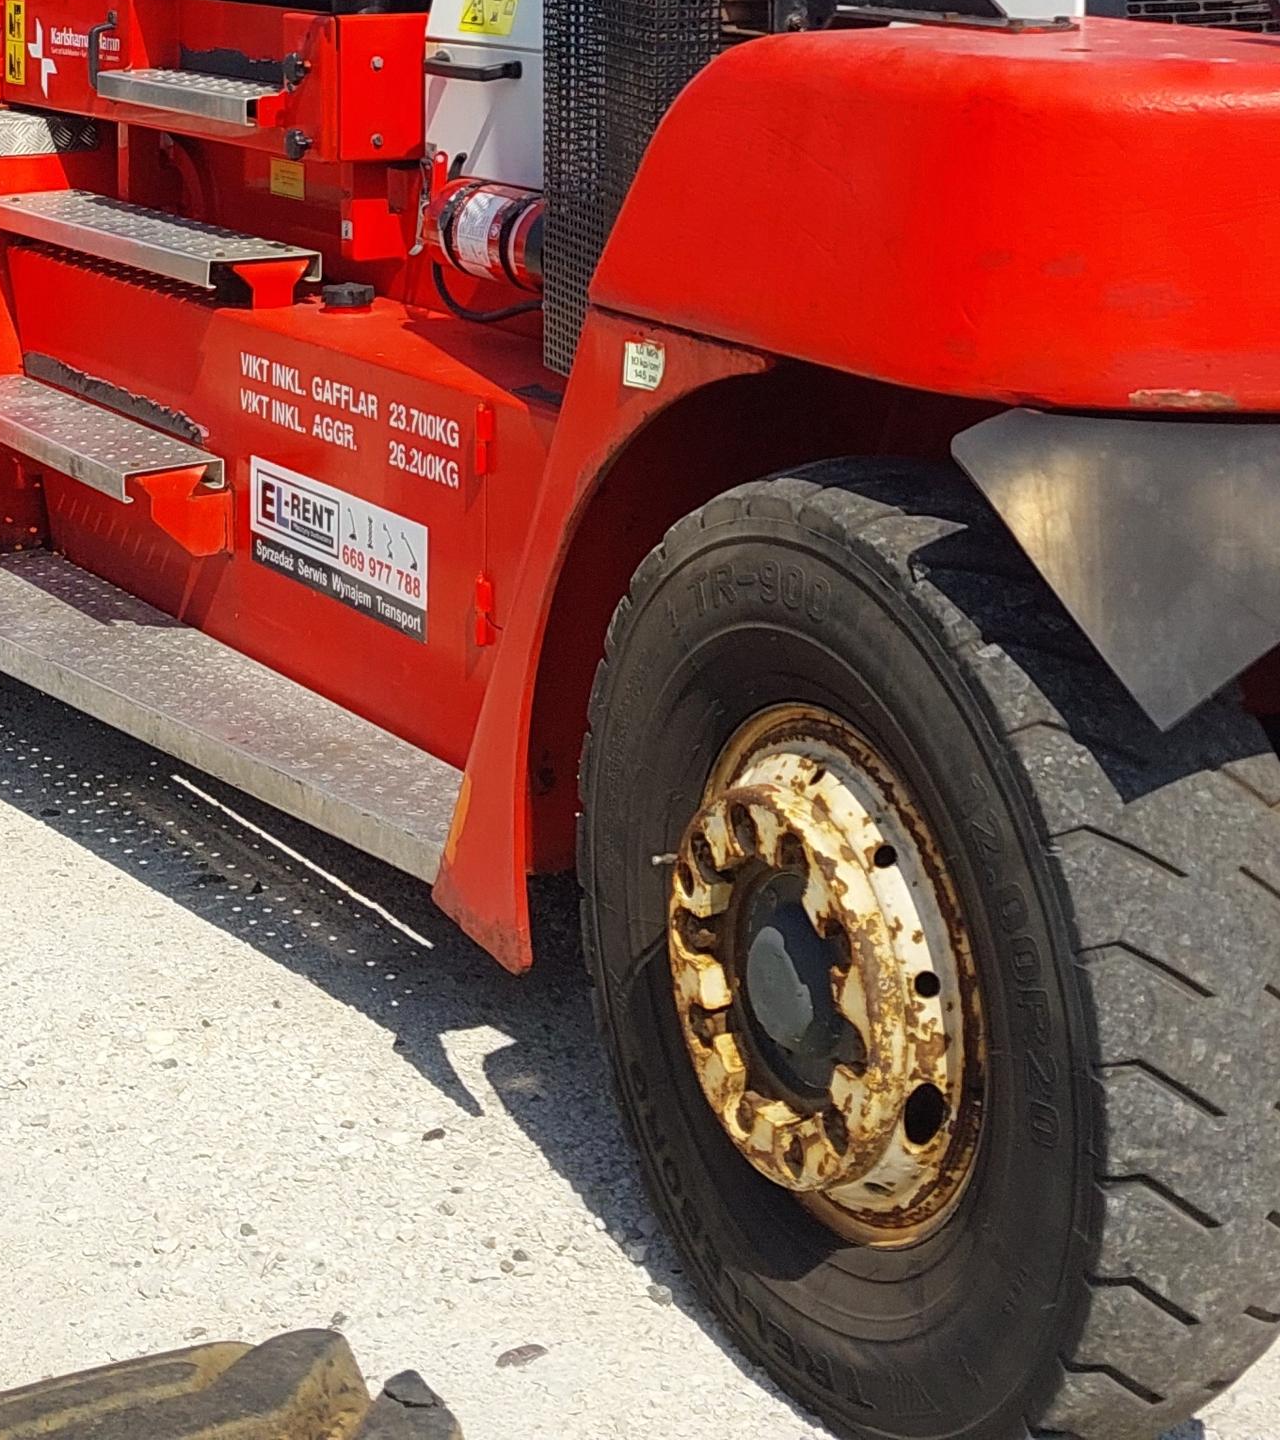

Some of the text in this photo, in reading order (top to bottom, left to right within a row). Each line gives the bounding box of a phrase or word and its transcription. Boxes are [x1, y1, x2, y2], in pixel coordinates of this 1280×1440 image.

[240, 351, 460, 448] VIKT INKL. GAFFLAR 23.700KG
[240, 388, 460, 489] VIKT INKL. AGGR. 26.200KG
[261, 479, 335, 533] EL-RENT
[256, 539, 422, 633] Sprzedaż Serwis Wynajem Transport
[342, 544, 421, 599] 669 977 788
[687, 560, 832, 621] TR-900
